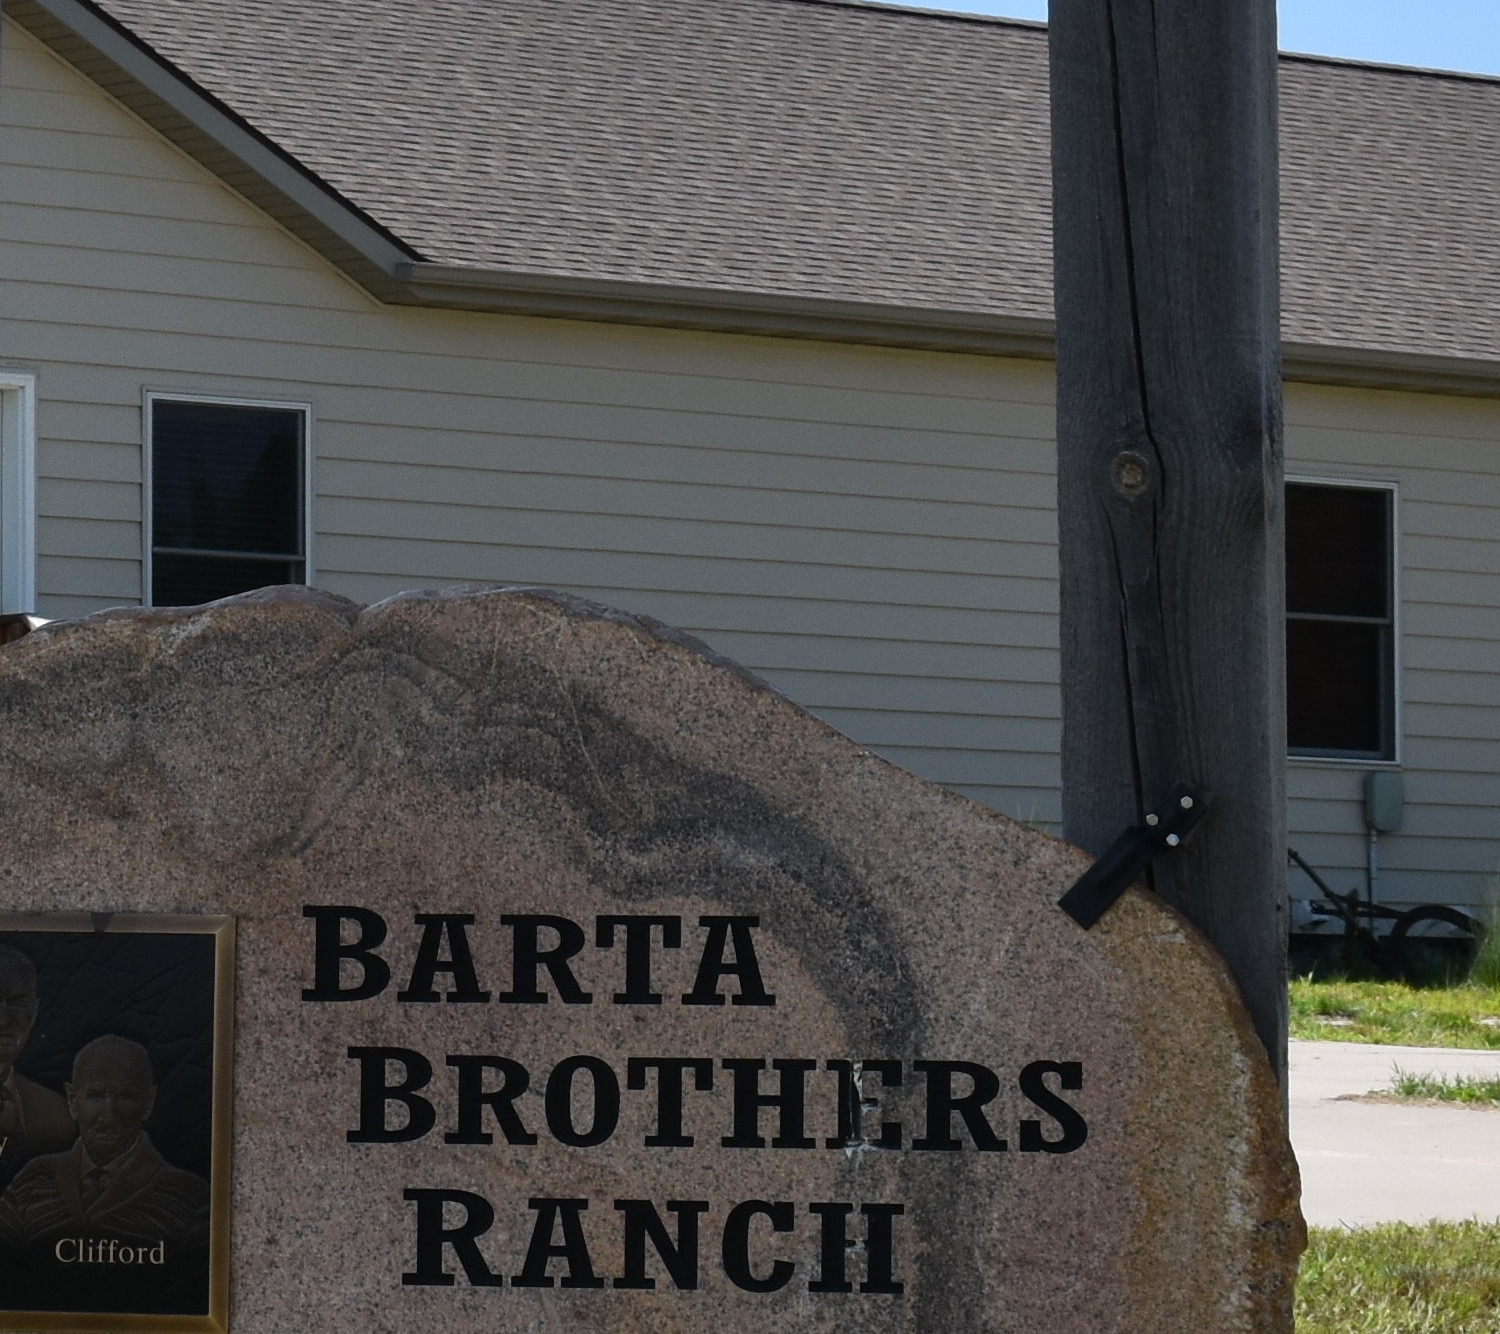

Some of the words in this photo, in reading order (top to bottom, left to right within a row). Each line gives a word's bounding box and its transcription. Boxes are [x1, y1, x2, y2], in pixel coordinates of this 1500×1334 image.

[301, 905, 777, 1006] BARTA
[345, 1046, 1089, 1154] BROTHERS
[55, 1238, 165, 1265] Clifford
[400, 1188, 905, 1294] RANCH
